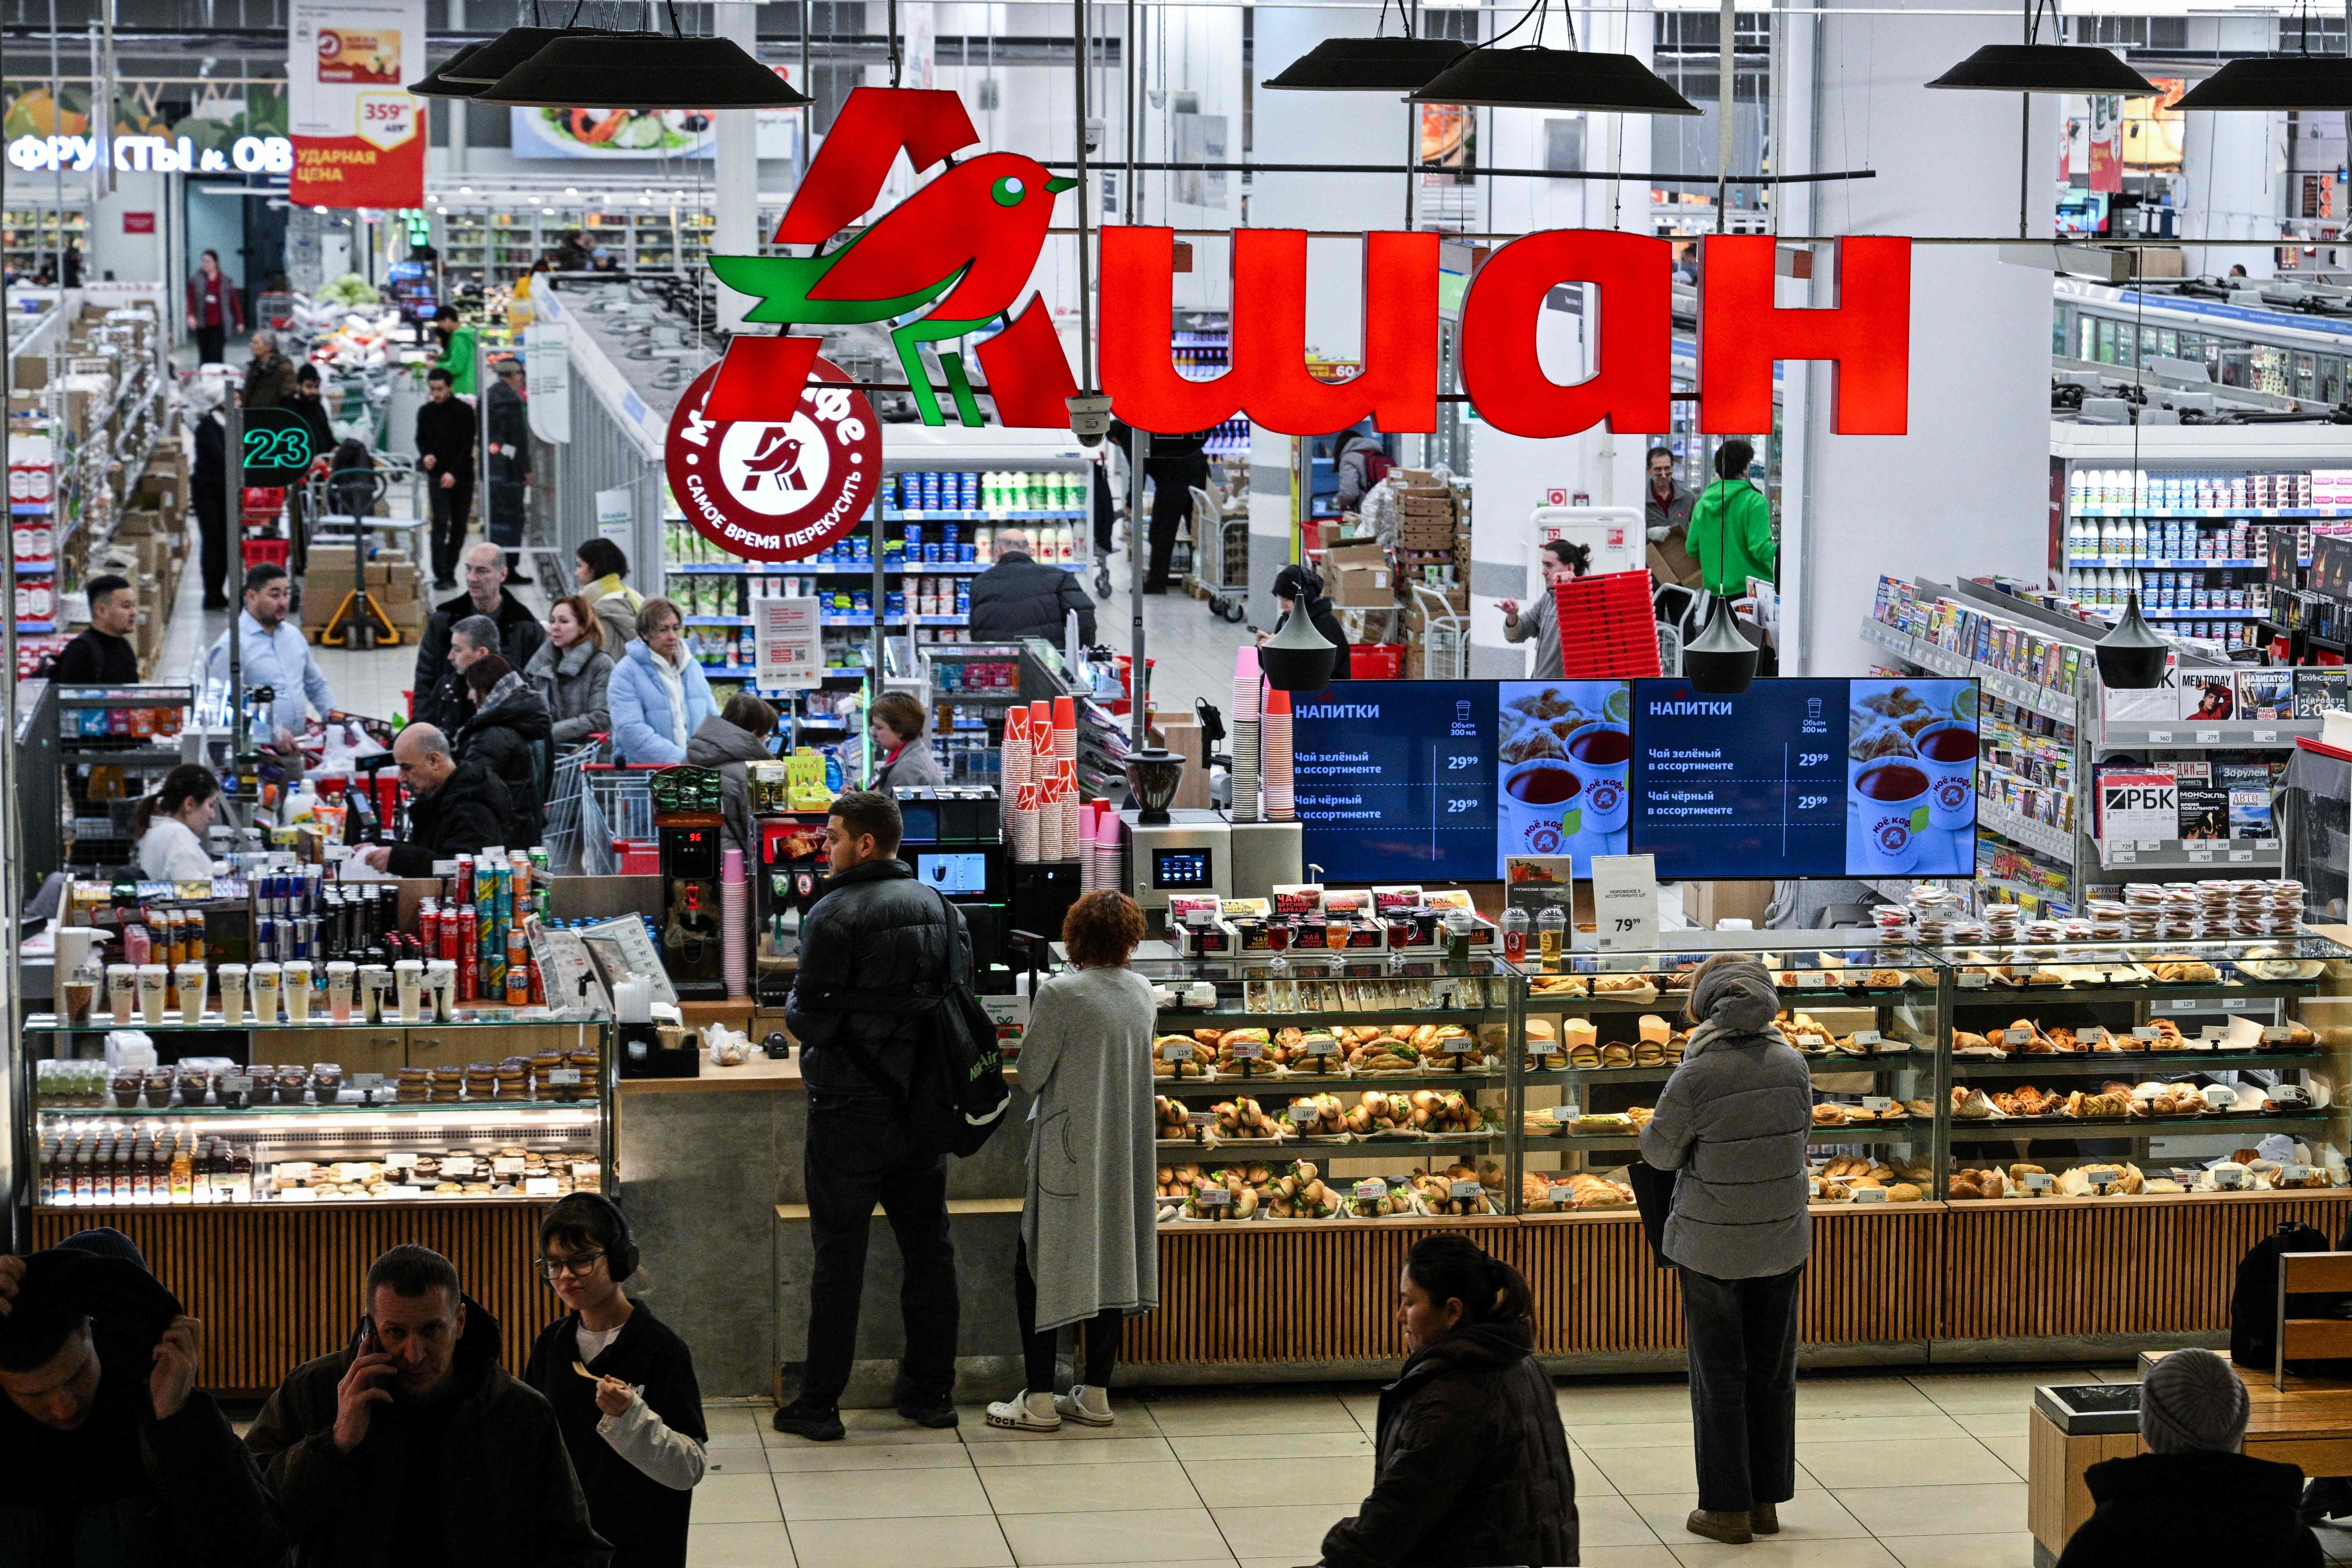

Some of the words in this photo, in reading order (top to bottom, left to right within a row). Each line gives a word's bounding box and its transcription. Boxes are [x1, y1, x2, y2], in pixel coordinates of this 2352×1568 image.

[200, 148, 228, 171] и
[297, 149, 377, 165] УДАРНАЯ
[296, 168, 343, 183] ЦЕНА
[244, 427, 311, 468] 23
[686, 474, 727, 529] САМОЕ
[724, 523, 781, 549] ВРЕМЯ
[785, 471, 862, 549] ПЕРЕКУСИТЬ
[1548, 531, 1559, 540] 32
[2183, 675, 2202, 686] MEN
[2203, 675, 2231, 686] TODAY
[2241, 675, 2289, 688] НАВИГАТОР
[2298, 673, 2345, 682] ТехИнсайдер
[1296, 705, 1379, 718] НАПИТКИ
[1650, 702, 1732, 715] НАПИТКИ
[1295, 752, 1316, 762] Чай
[1319, 752, 1369, 762] зелёный
[1649, 748, 1670, 758] Чай
[1672, 748, 1721, 758] зелёный
[1304, 766, 1381, 776] ассортименте
[1658, 761, 1733, 772] ассортименте
[1585, 778, 1601, 794] моё
[1603, 779, 1624, 793] кафе
[1933, 776, 1948, 791] моё
[1951, 777, 1971, 790] кафе
[1295, 795, 1316, 804] Чай
[1318, 795, 1362, 807] чёрный
[1648, 791, 1669, 801] Чай
[1671, 790, 1714, 804] чёрный
[2127, 789, 2175, 809] РБК
[2234, 793, 2258, 802] АВТО
[1303, 811, 1381, 821] ассортименте
[1657, 806, 1733, 817] ассортименте
[1524, 820, 1541, 837] моё
[1544, 820, 1563, 835] каф
[1872, 816, 1890, 833] моё
[1891, 817, 1911, 832] каф
[690, 833, 701, 841] 96
